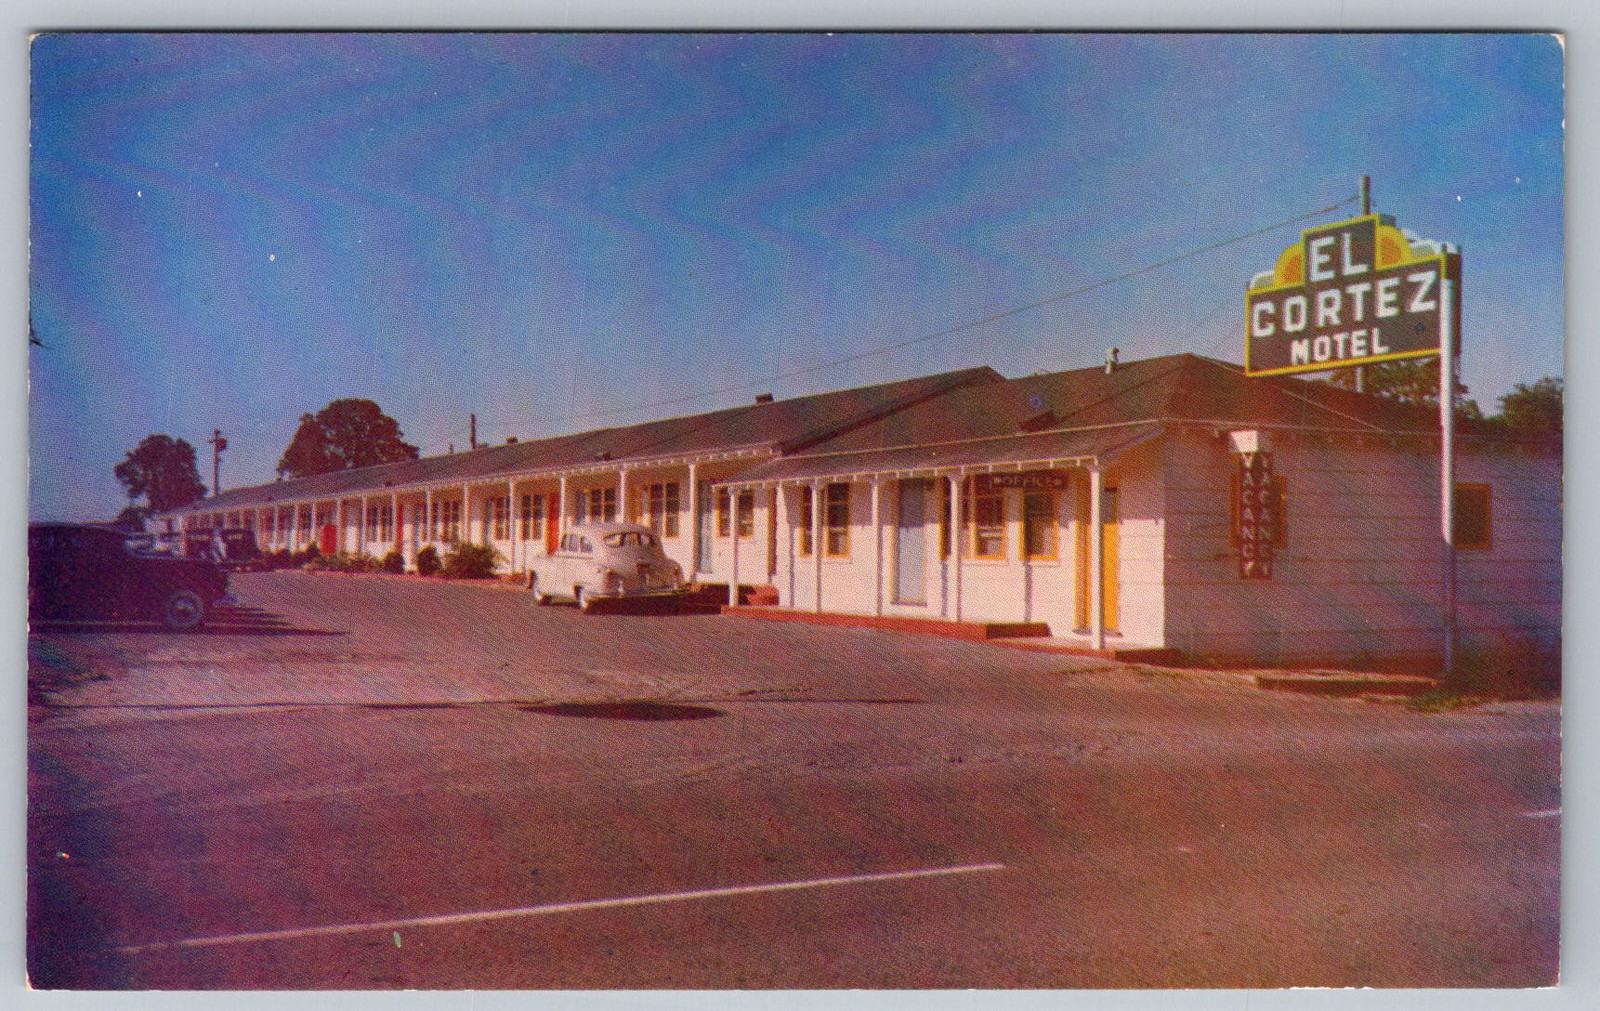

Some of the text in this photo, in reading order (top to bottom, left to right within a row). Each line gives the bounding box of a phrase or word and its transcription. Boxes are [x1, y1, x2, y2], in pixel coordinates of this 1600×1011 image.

[1309, 232, 1369, 282] EL
[1252, 270, 1437, 338] CORTEZ
[1290, 327, 1390, 366] MOTEL
[1242, 453, 1255, 574] VACANCY
